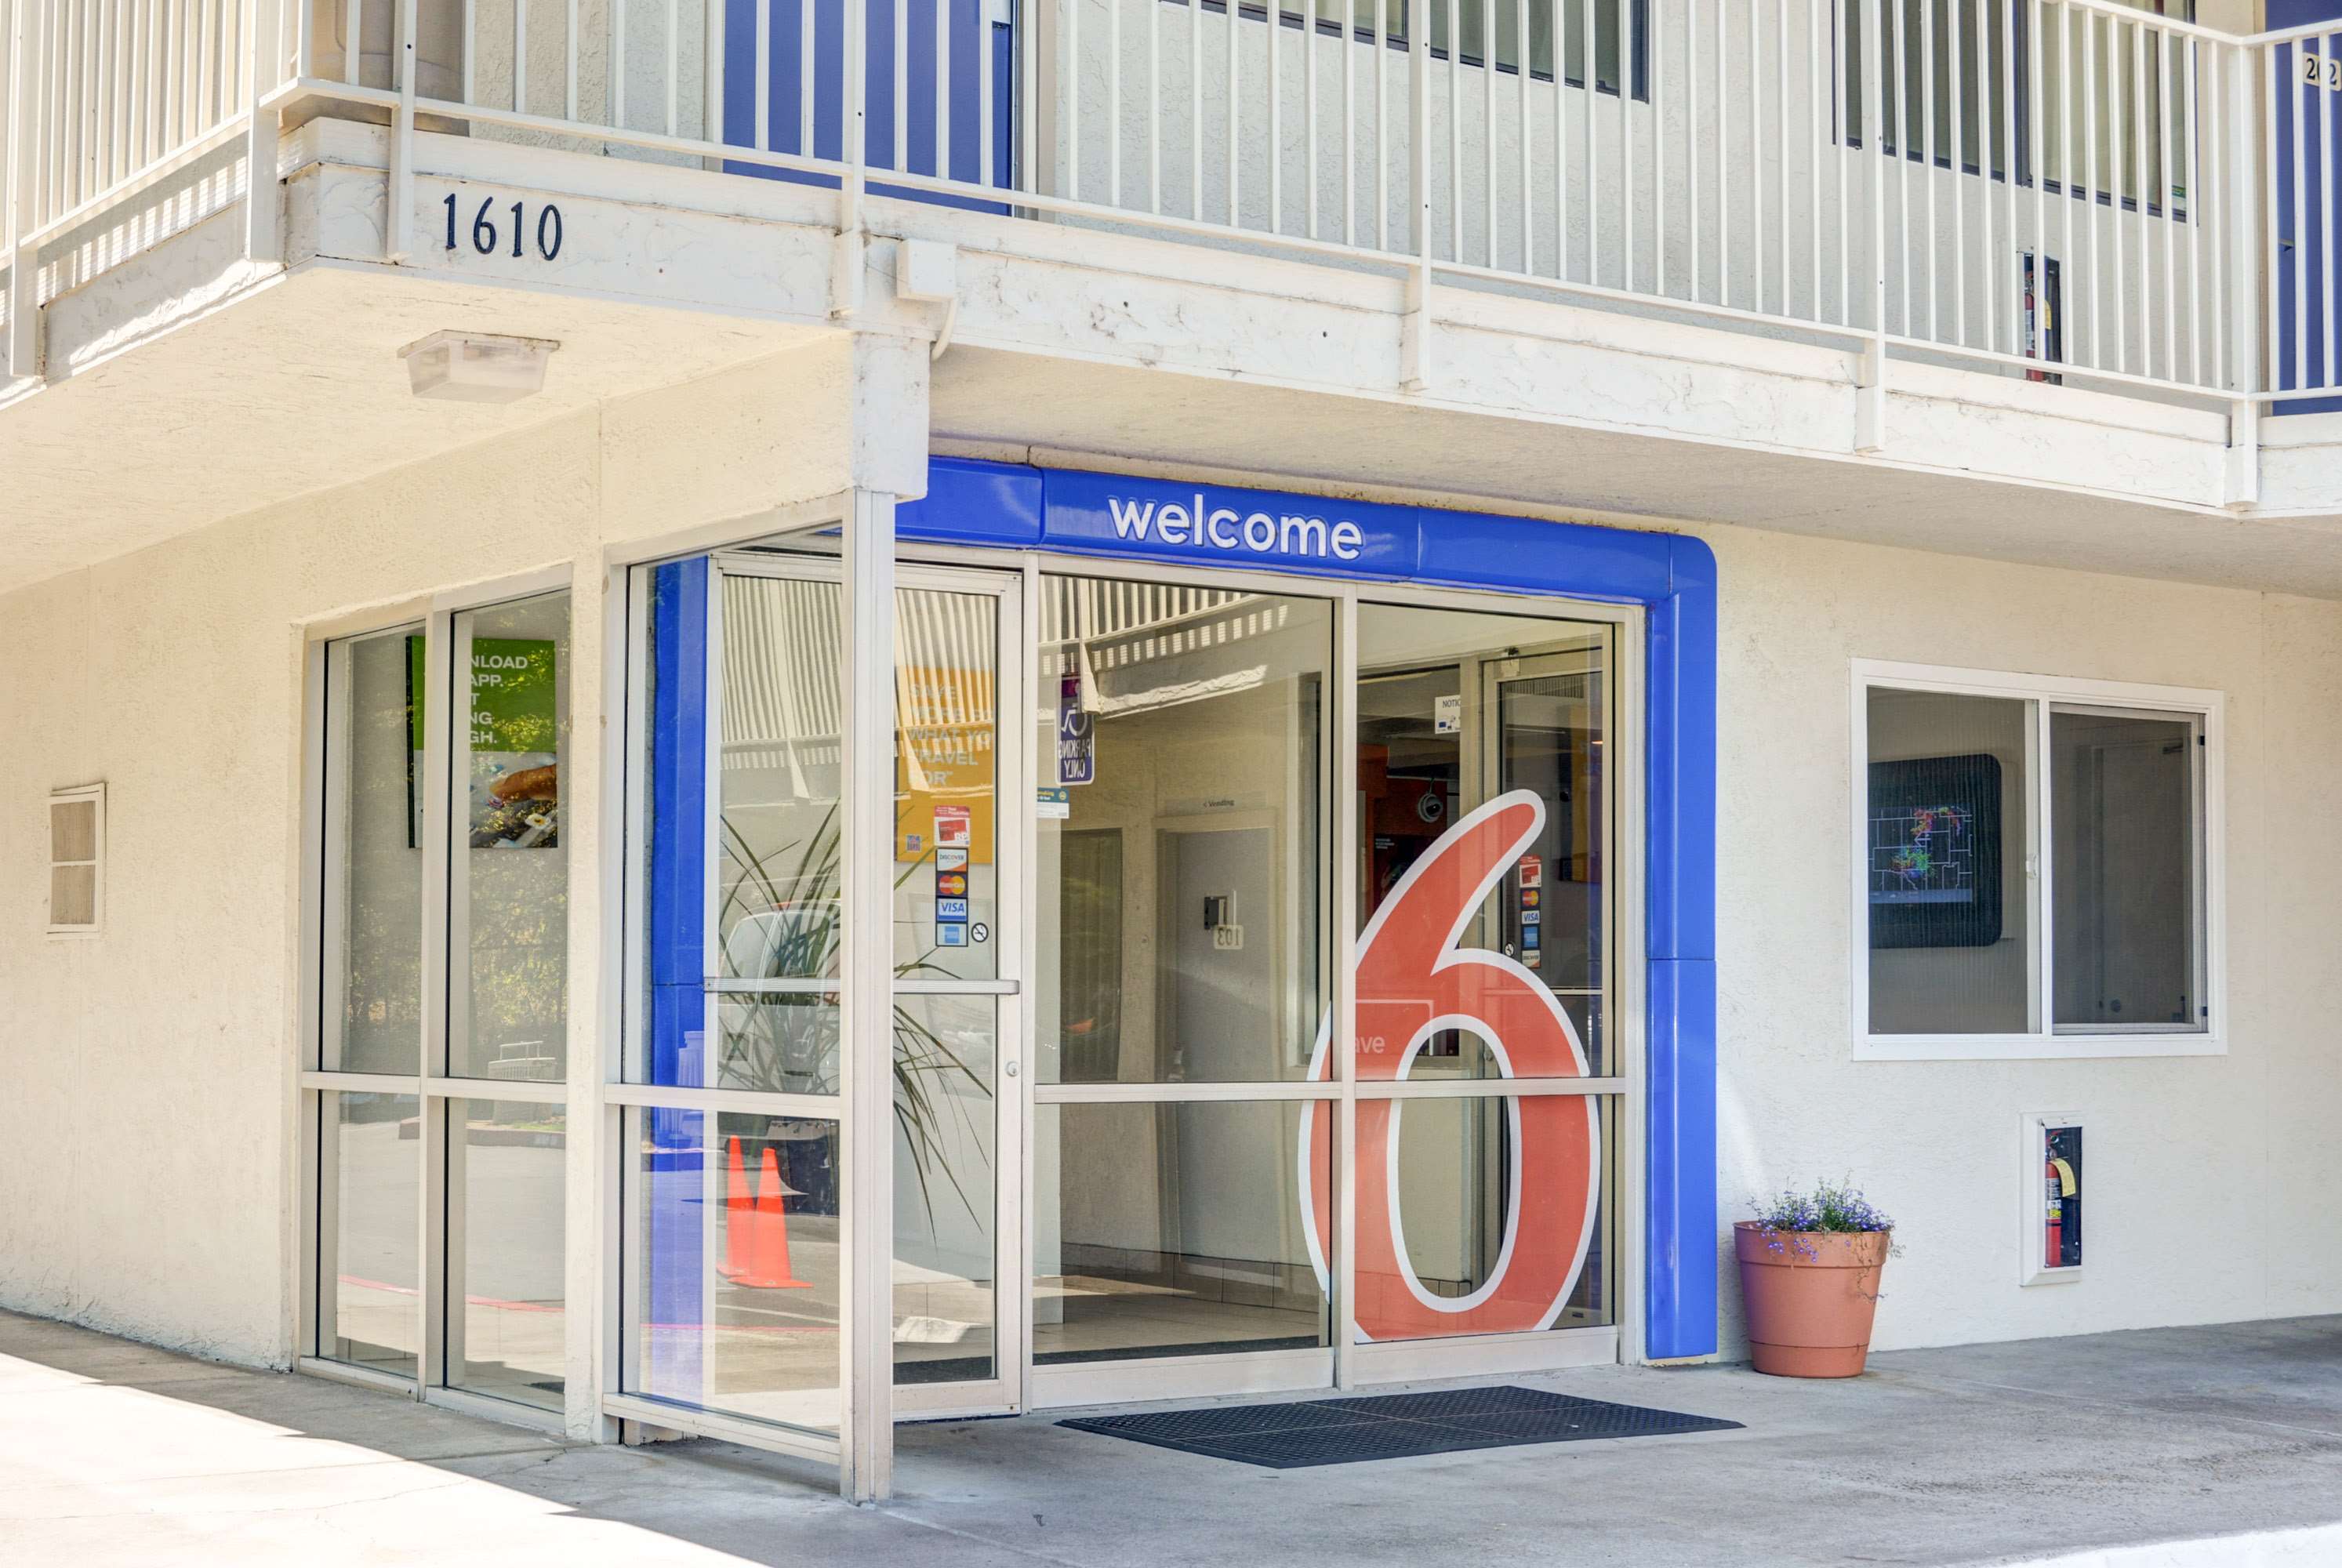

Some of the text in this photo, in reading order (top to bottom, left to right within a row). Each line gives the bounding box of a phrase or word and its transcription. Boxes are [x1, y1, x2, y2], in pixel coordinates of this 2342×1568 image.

[2306, 57, 2337, 85] 22
[444, 193, 563, 261] 1610
[1108, 493, 1363, 560] welcome
[470, 655, 528, 670] NLOAD
[1443, 699, 1461, 709] NOTIC
[941, 902, 965, 913] VISA
[1523, 912, 1539, 923] VISA
